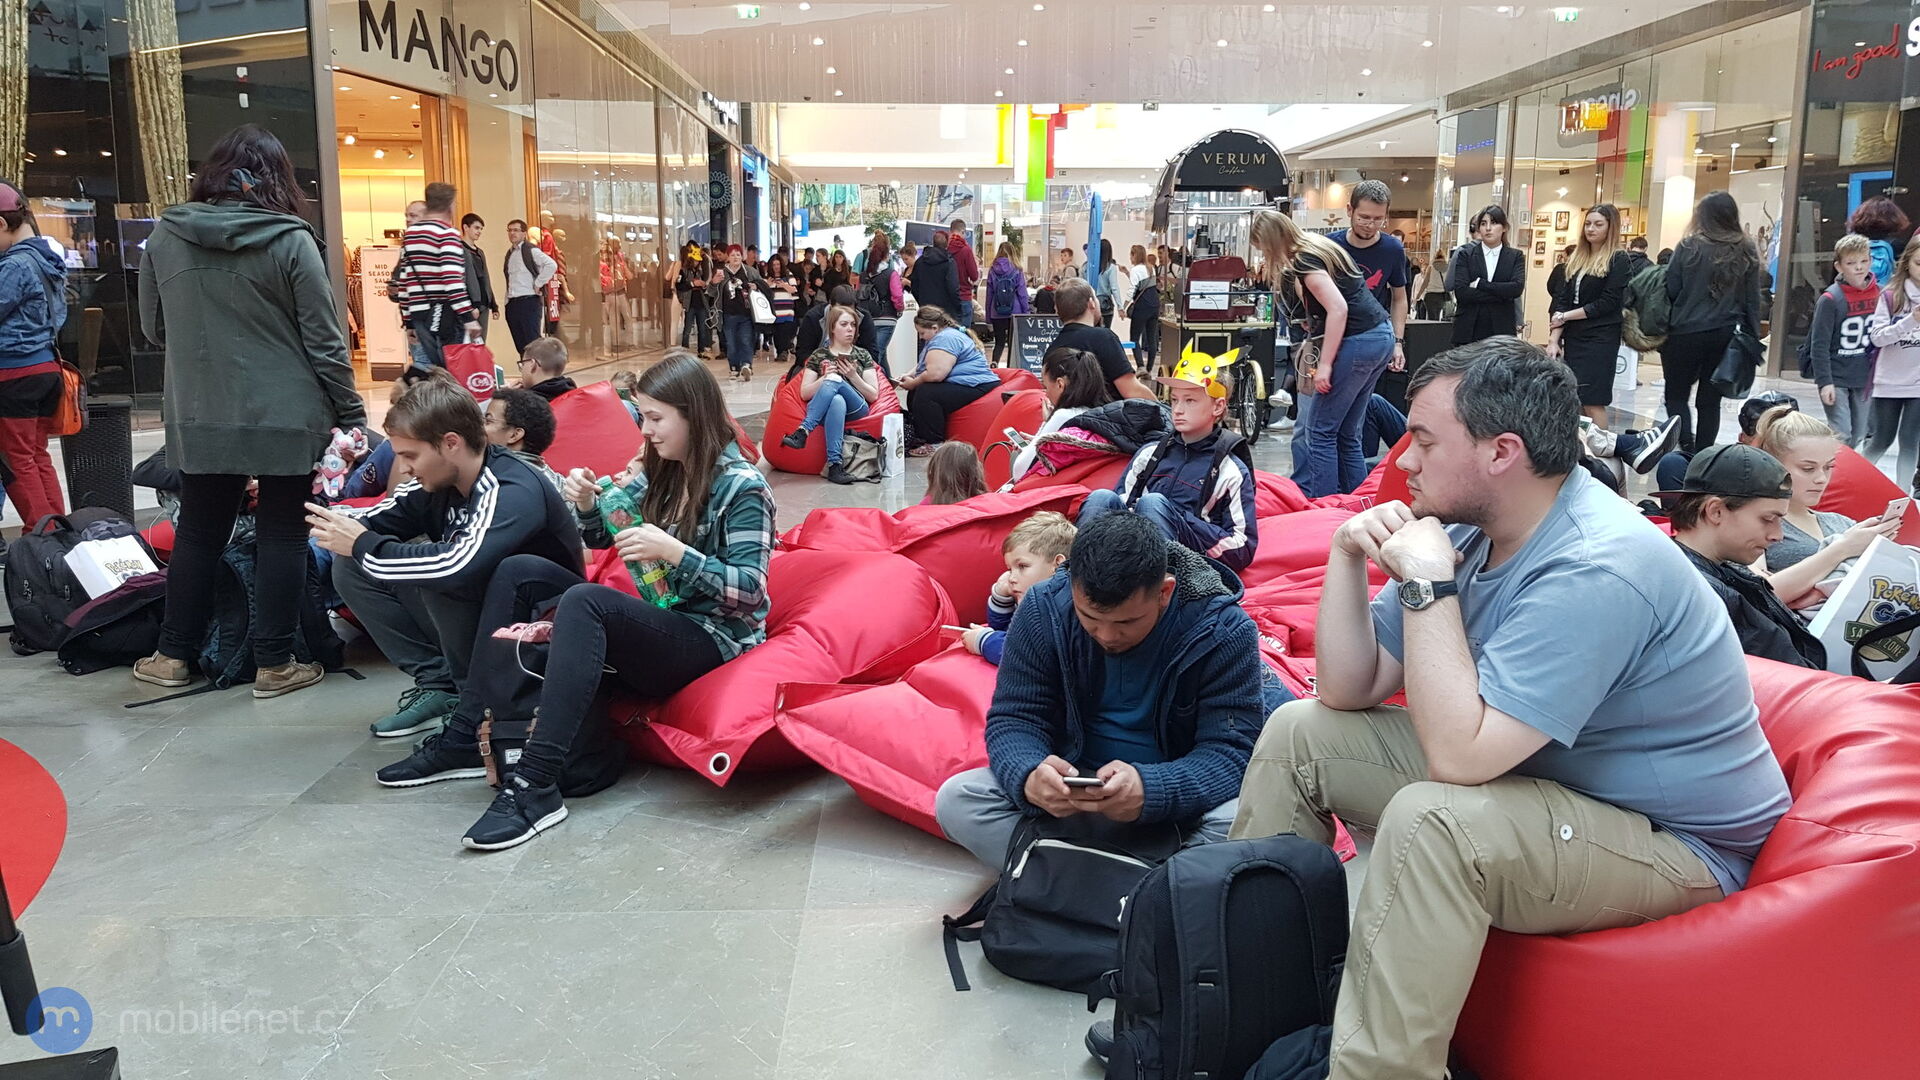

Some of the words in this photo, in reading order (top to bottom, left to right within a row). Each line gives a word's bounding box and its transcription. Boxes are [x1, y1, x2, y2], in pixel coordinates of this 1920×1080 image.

[359, 0, 518, 91] MANGO
[1813, 49, 1821, 72] I
[1823, 57, 1848, 71] am
[1202, 152, 1266, 165] VERUM
[1218, 166, 1246, 175] Coffee
[1026, 319, 1064, 328] VERU
[1882, 640, 1905, 657] ZONE
